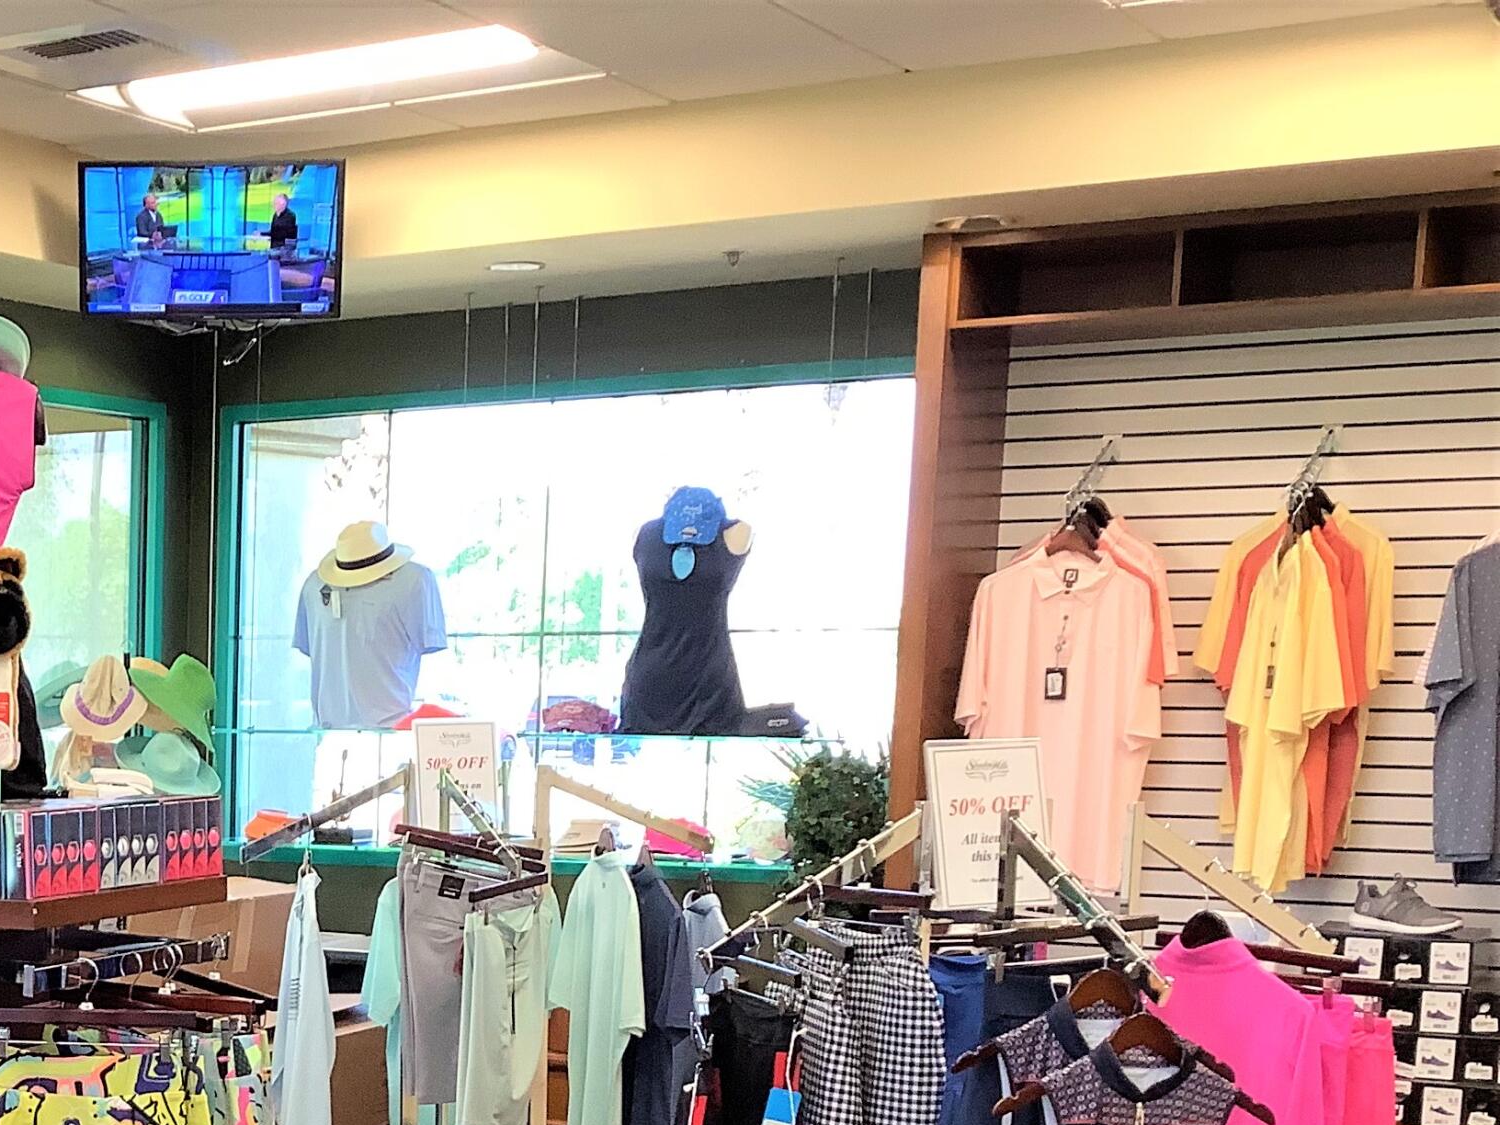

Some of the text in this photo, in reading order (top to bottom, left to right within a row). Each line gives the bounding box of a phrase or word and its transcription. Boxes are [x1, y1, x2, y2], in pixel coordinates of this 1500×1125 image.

[426, 756, 489, 770] 50% OFF
[949, 795, 1034, 817] 50% OFF
[960, 833, 978, 846] All
[972, 850, 992, 862] this
